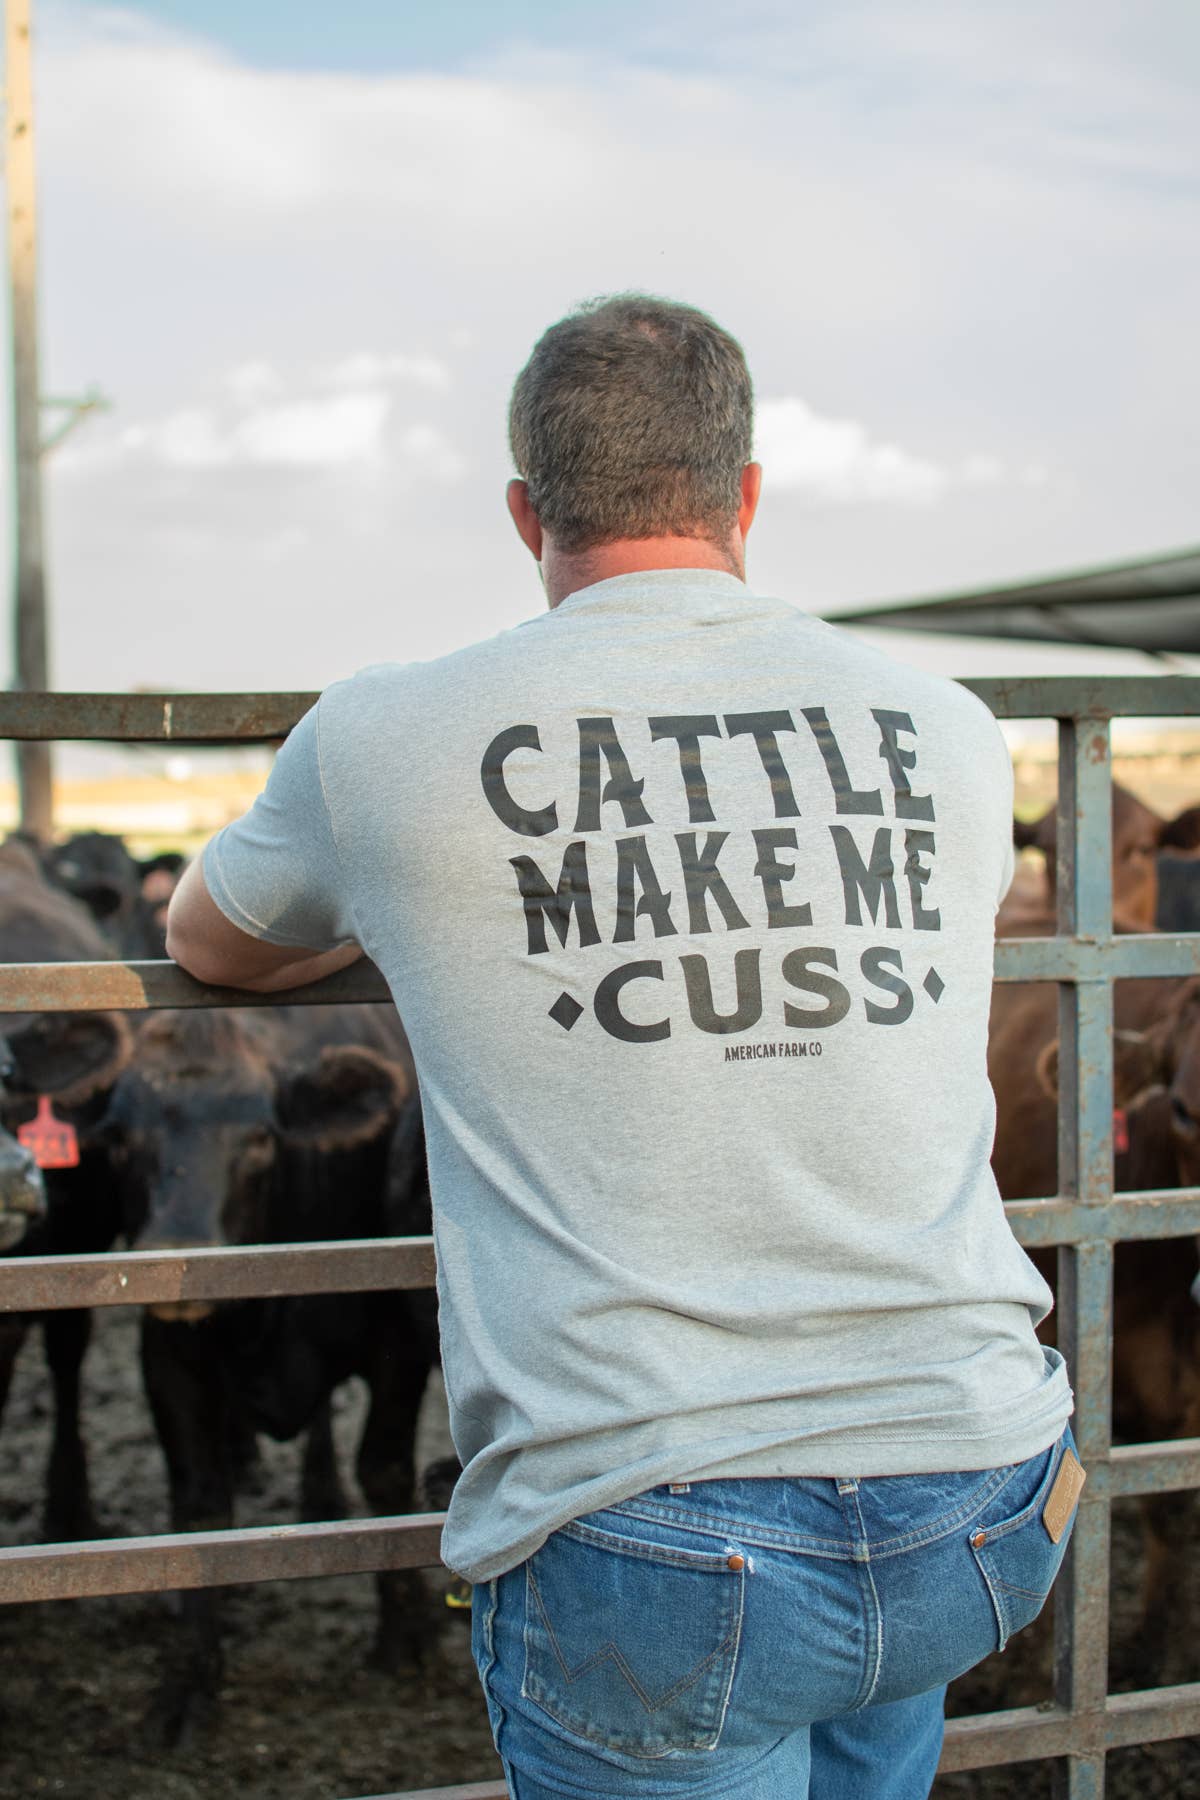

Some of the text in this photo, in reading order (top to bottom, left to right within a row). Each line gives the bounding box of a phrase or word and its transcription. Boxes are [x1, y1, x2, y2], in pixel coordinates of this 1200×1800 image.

[480, 706, 936, 838] CATTLE
[508, 825, 941, 956] MAKE ME
[593, 946, 915, 1043] CUSS
[724, 1041, 823, 1062] AMERICAN FARM CO
